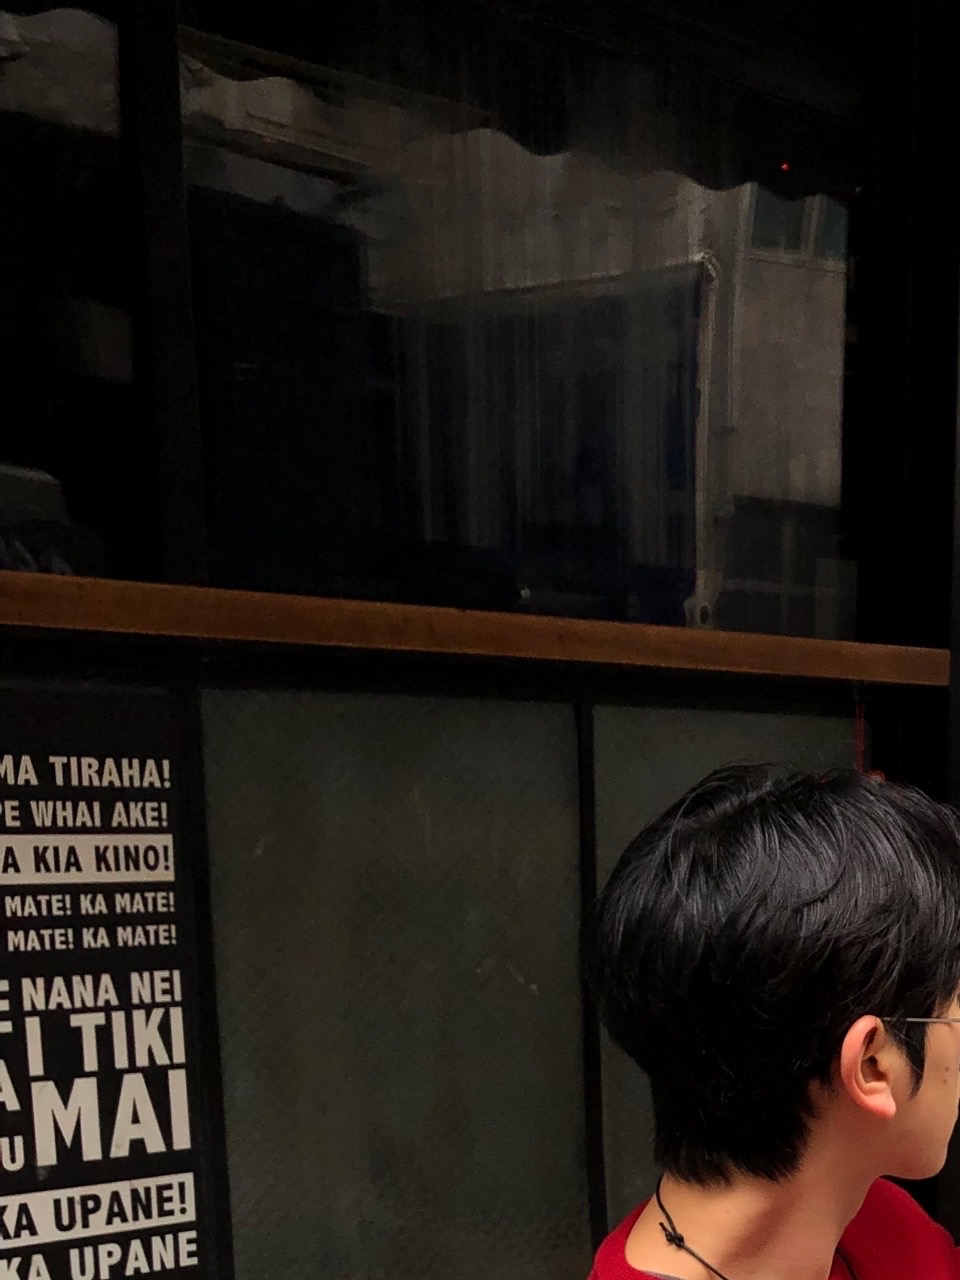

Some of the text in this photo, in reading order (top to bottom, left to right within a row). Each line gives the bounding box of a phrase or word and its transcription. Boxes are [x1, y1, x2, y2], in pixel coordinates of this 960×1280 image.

[0, 754, 171, 788] MA TIRAHA!
[0, 800, 168, 828] E WHAI AKE!
[2, 844, 170, 873] A KIA KINO!
[5, 891, 175, 917] MATE! KA MATE!
[7, 924, 177, 951] MATE! KA MATE!
[21, 973, 119, 1011] NANA
[130, 969, 182, 1005] NEI
[70, 1006, 187, 1073] TIKI
[30, 1068, 192, 1167] MAI
[53, 1181, 188, 1232] UPANE!
